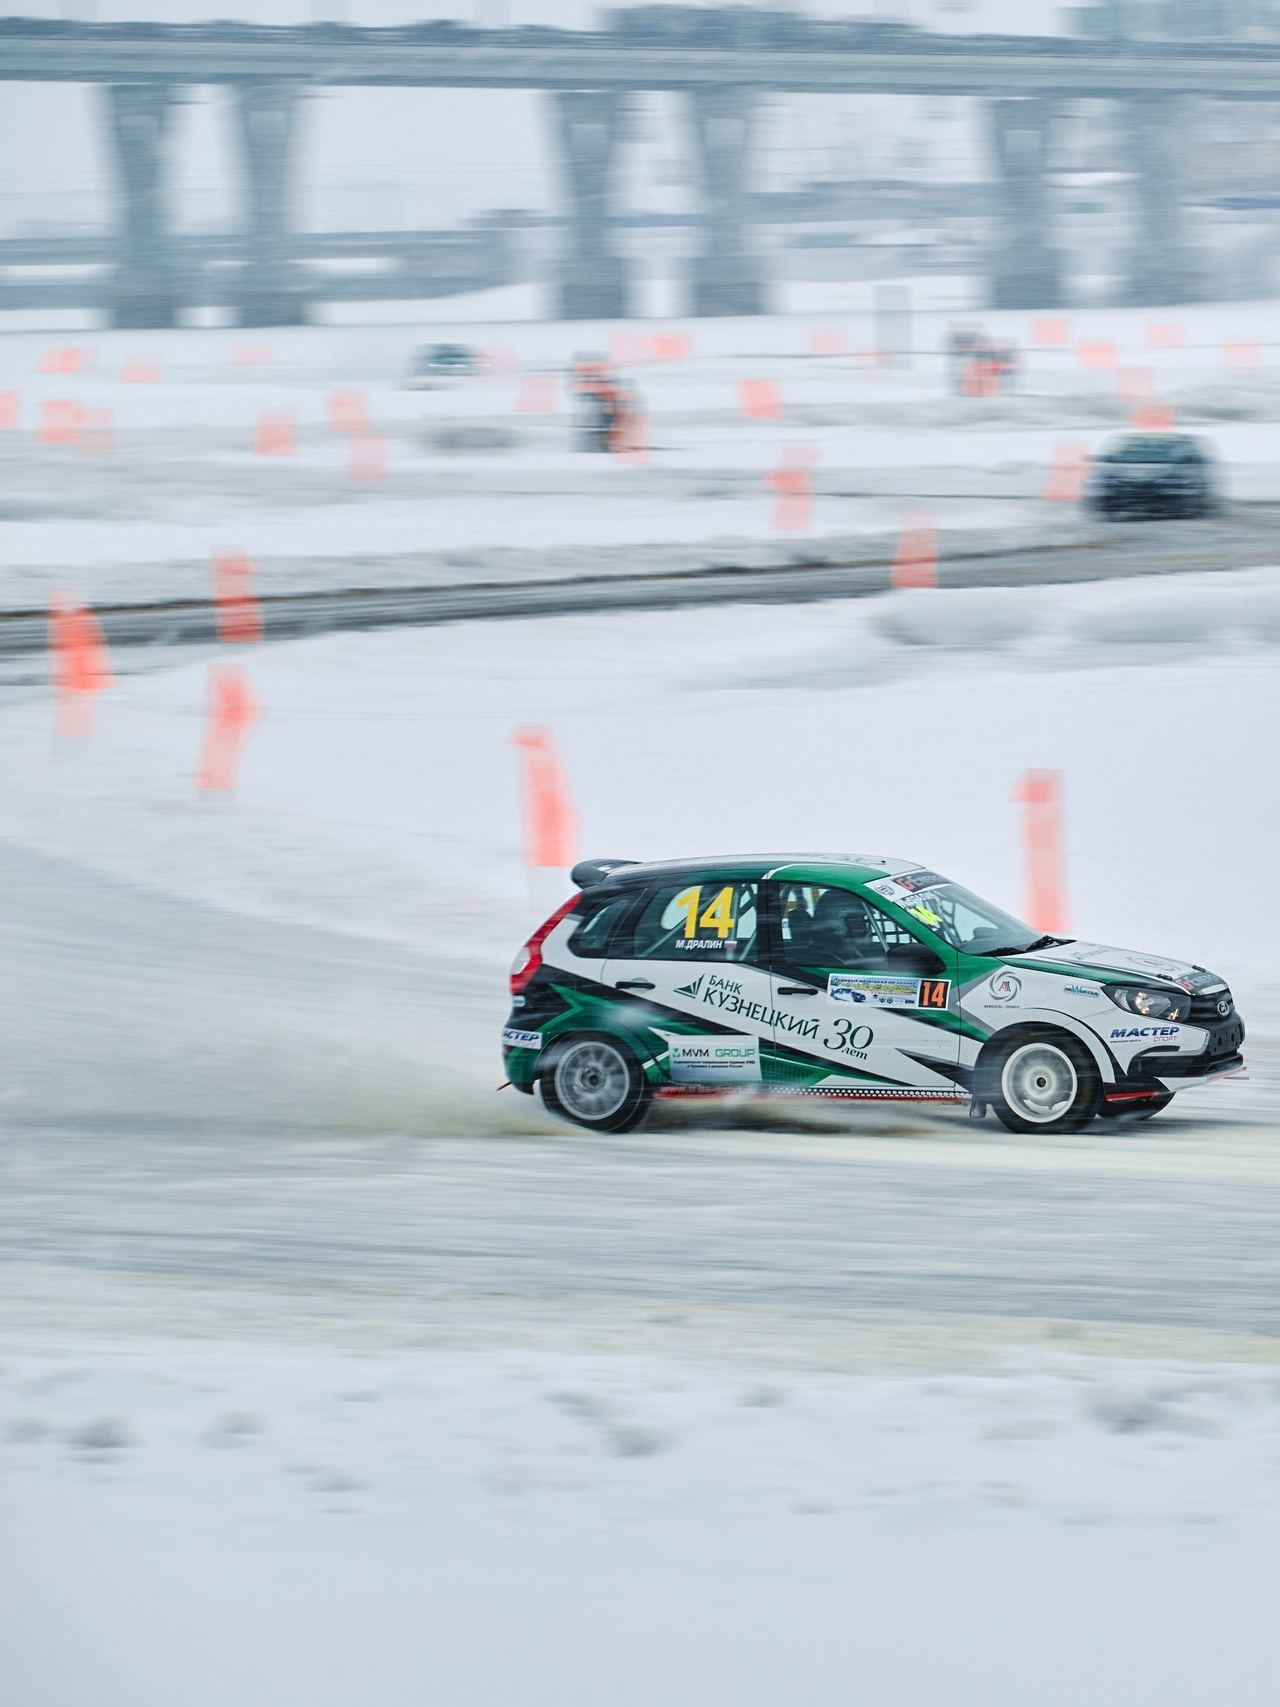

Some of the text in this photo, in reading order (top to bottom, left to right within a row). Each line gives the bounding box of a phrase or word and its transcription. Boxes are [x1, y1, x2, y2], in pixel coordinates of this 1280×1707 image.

[677, 886, 735, 938] 14
[675, 939, 722, 950] М.ДРАЛИН
[709, 974, 743, 994] БАНК
[923, 982, 945, 1007] 14
[702, 987, 821, 1039] КУЗНЕЦКИЙ
[823, 1018, 875, 1051] 30
[1110, 1026, 1180, 1038] МАСТЕР
[682, 1048, 756, 1058] MVM GROUP
[841, 1047, 868, 1060] лет
